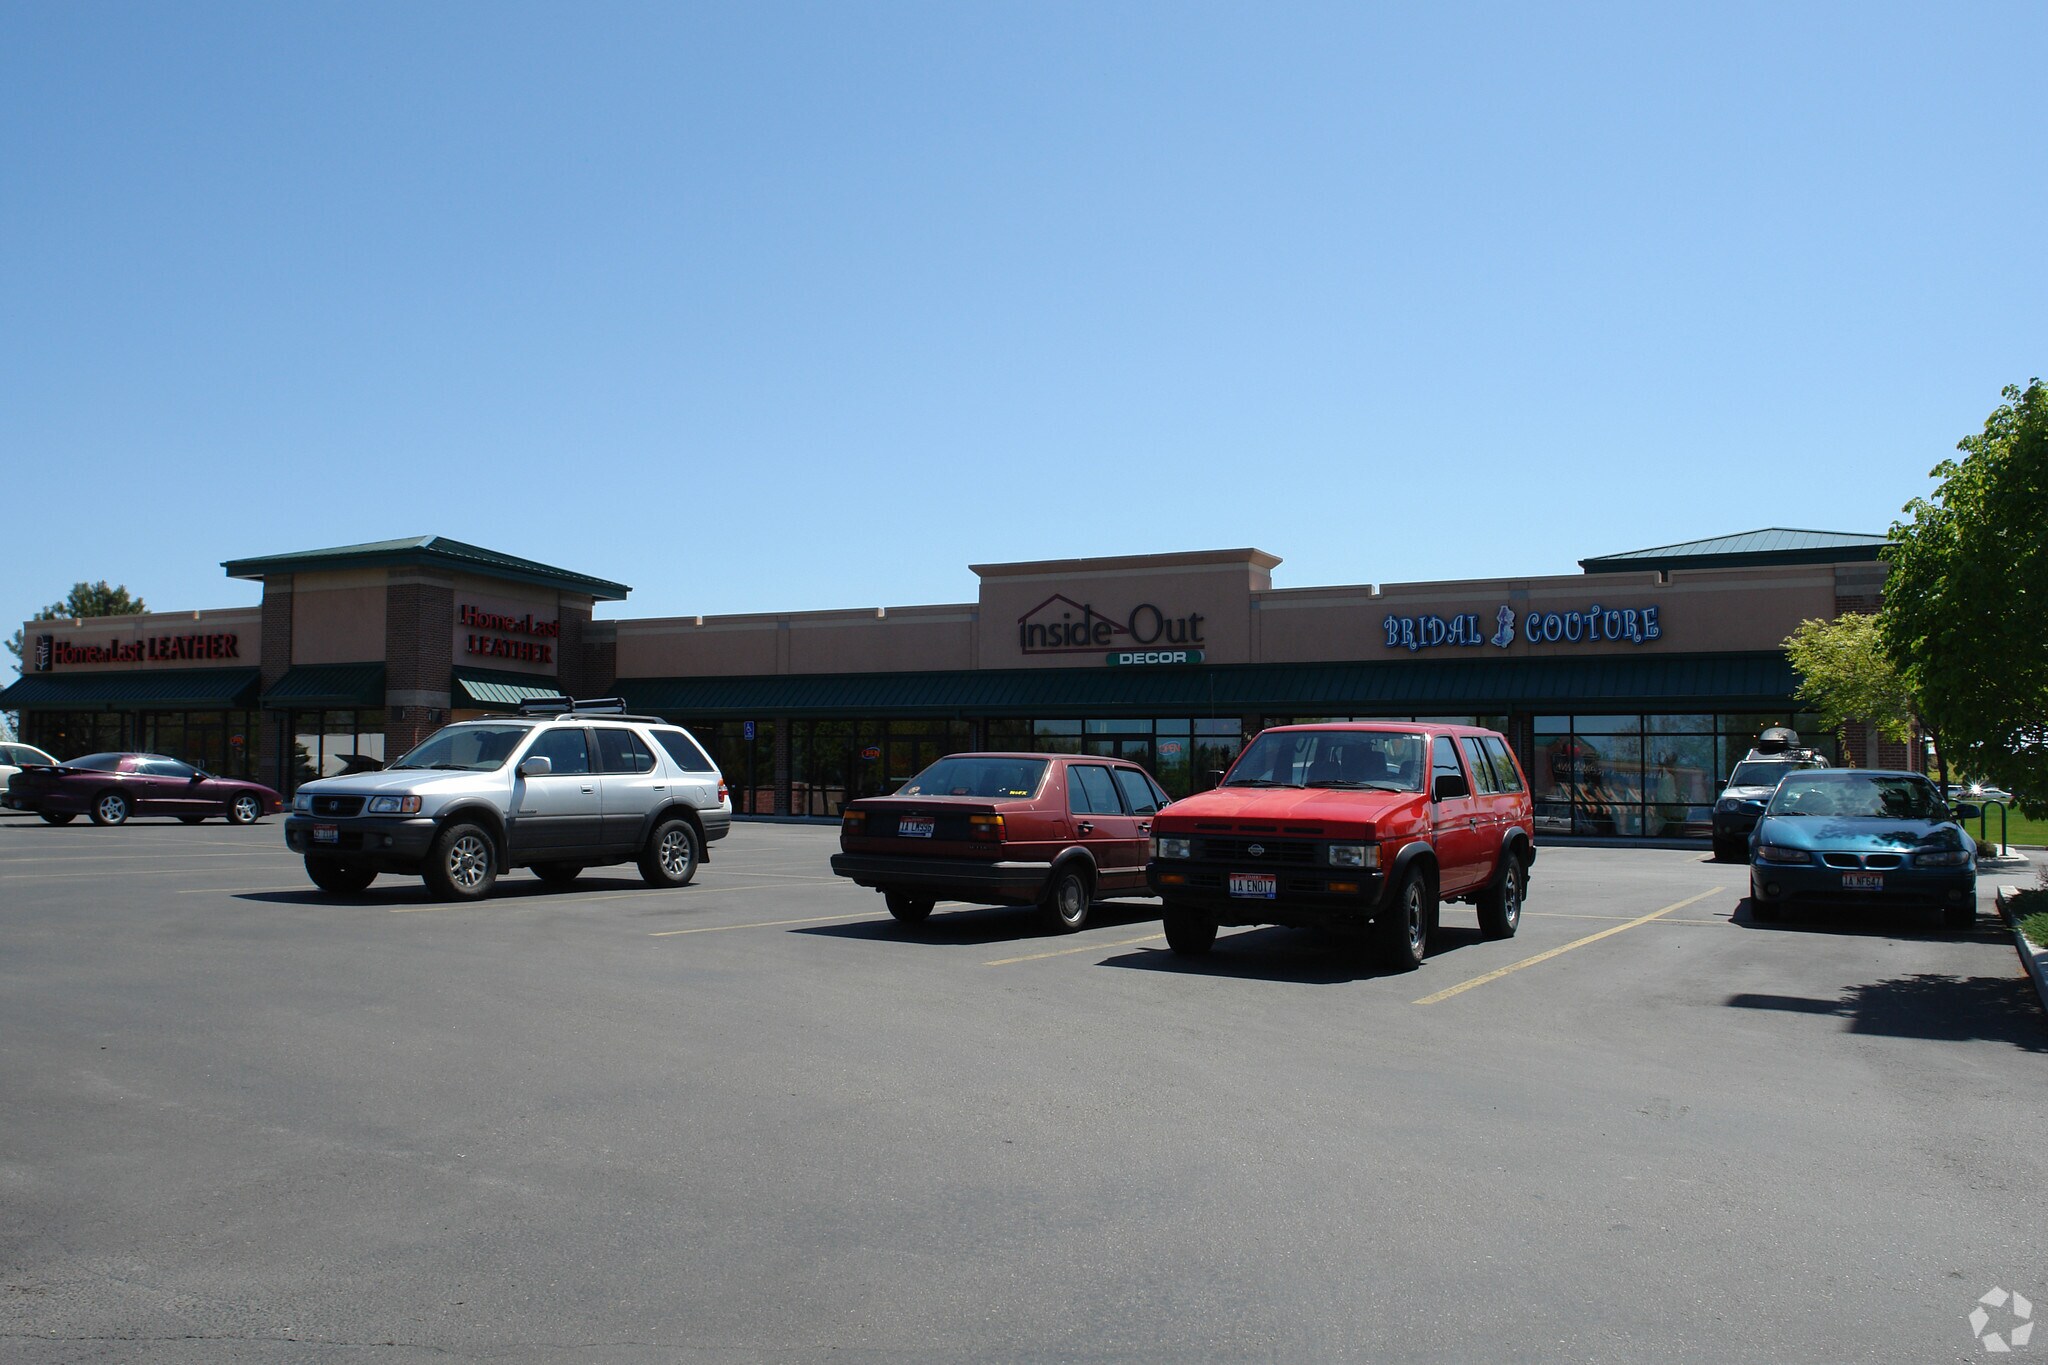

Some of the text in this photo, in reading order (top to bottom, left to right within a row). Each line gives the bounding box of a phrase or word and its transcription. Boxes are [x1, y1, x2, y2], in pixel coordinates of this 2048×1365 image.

[461, 604, 515, 632] Home
[526, 614, 560, 638] Last
[1129, 603, 1204, 644] Out
[1384, 604, 1662, 651] BRIDAL COUTURE
[54, 641, 99, 664] Home
[111, 639, 145, 661] Last
[147, 634, 239, 661] LEATHER
[468, 635, 552, 664] LEATHER
[1119, 651, 1187, 665] DECOR
[1158, 743, 1181, 754] OPEN
